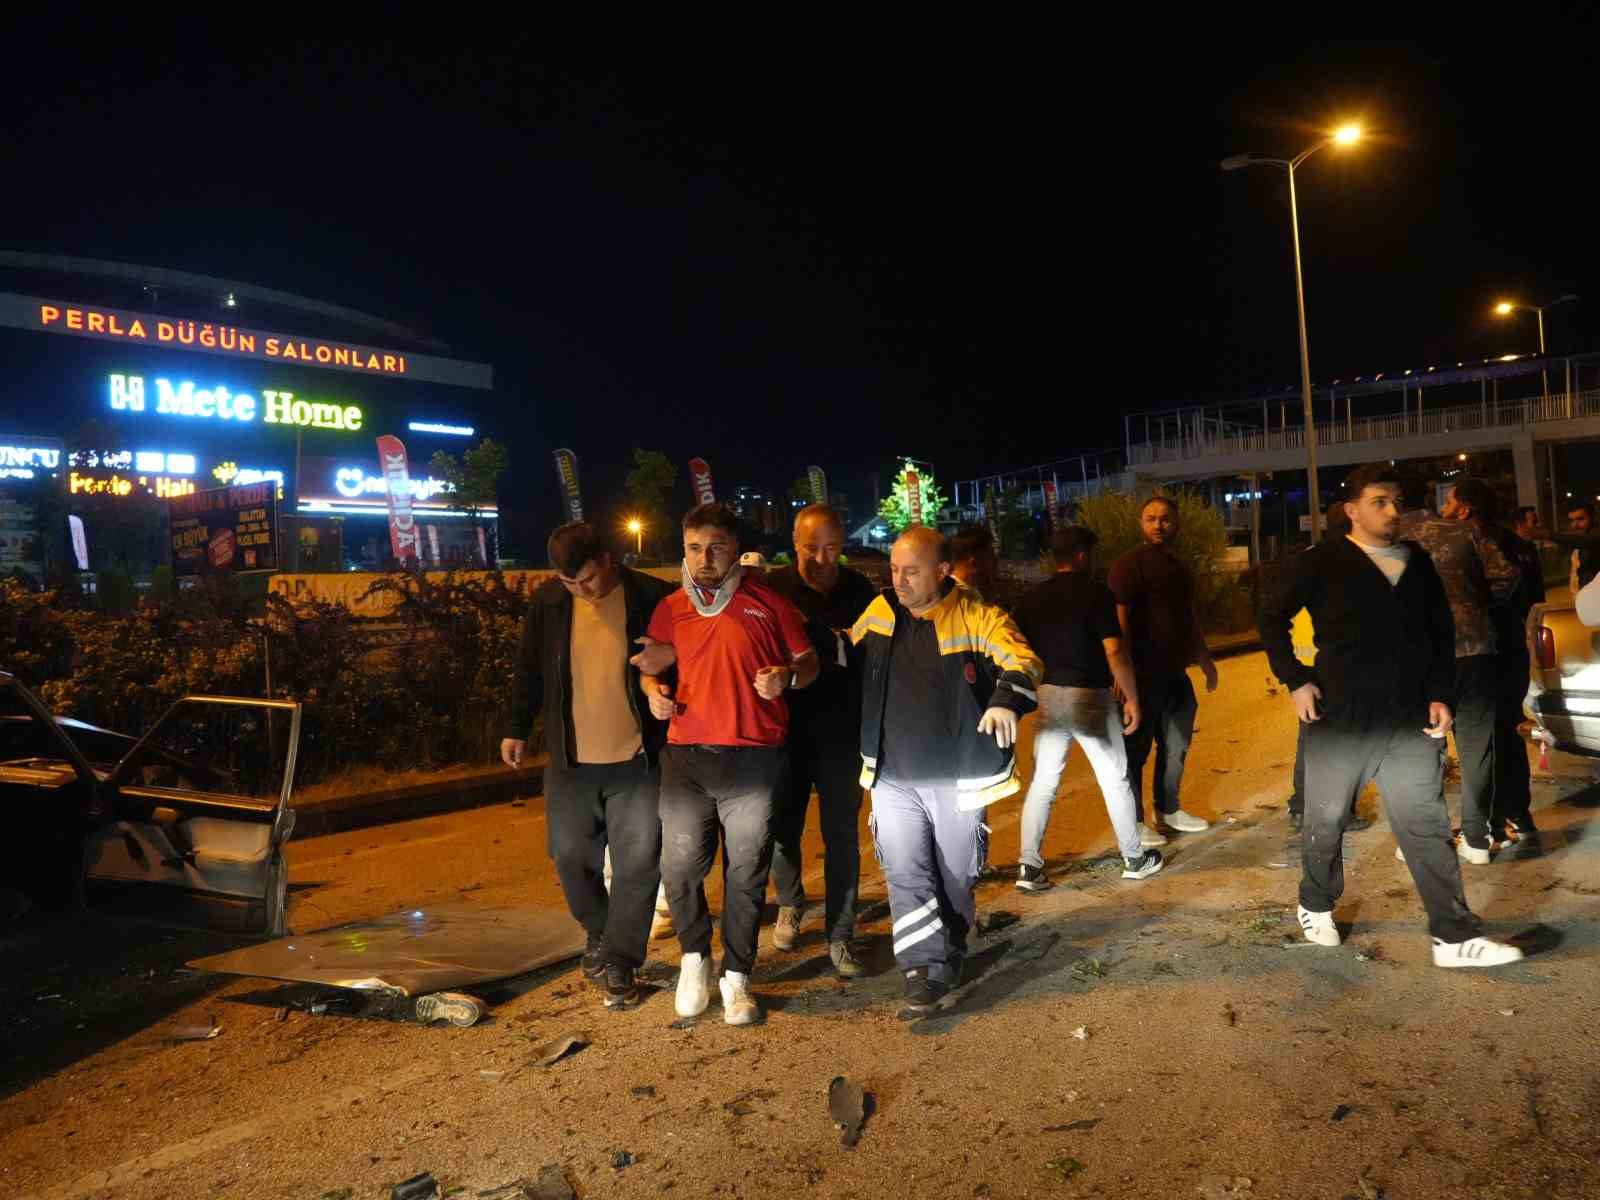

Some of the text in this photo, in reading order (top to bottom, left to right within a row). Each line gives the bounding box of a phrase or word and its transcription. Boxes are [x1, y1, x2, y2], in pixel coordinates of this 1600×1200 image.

[40, 304, 407, 373] PERLA DÜĞÜN SALONLARI
[155, 377, 256, 421] Mete
[262, 390, 363, 431] Home
